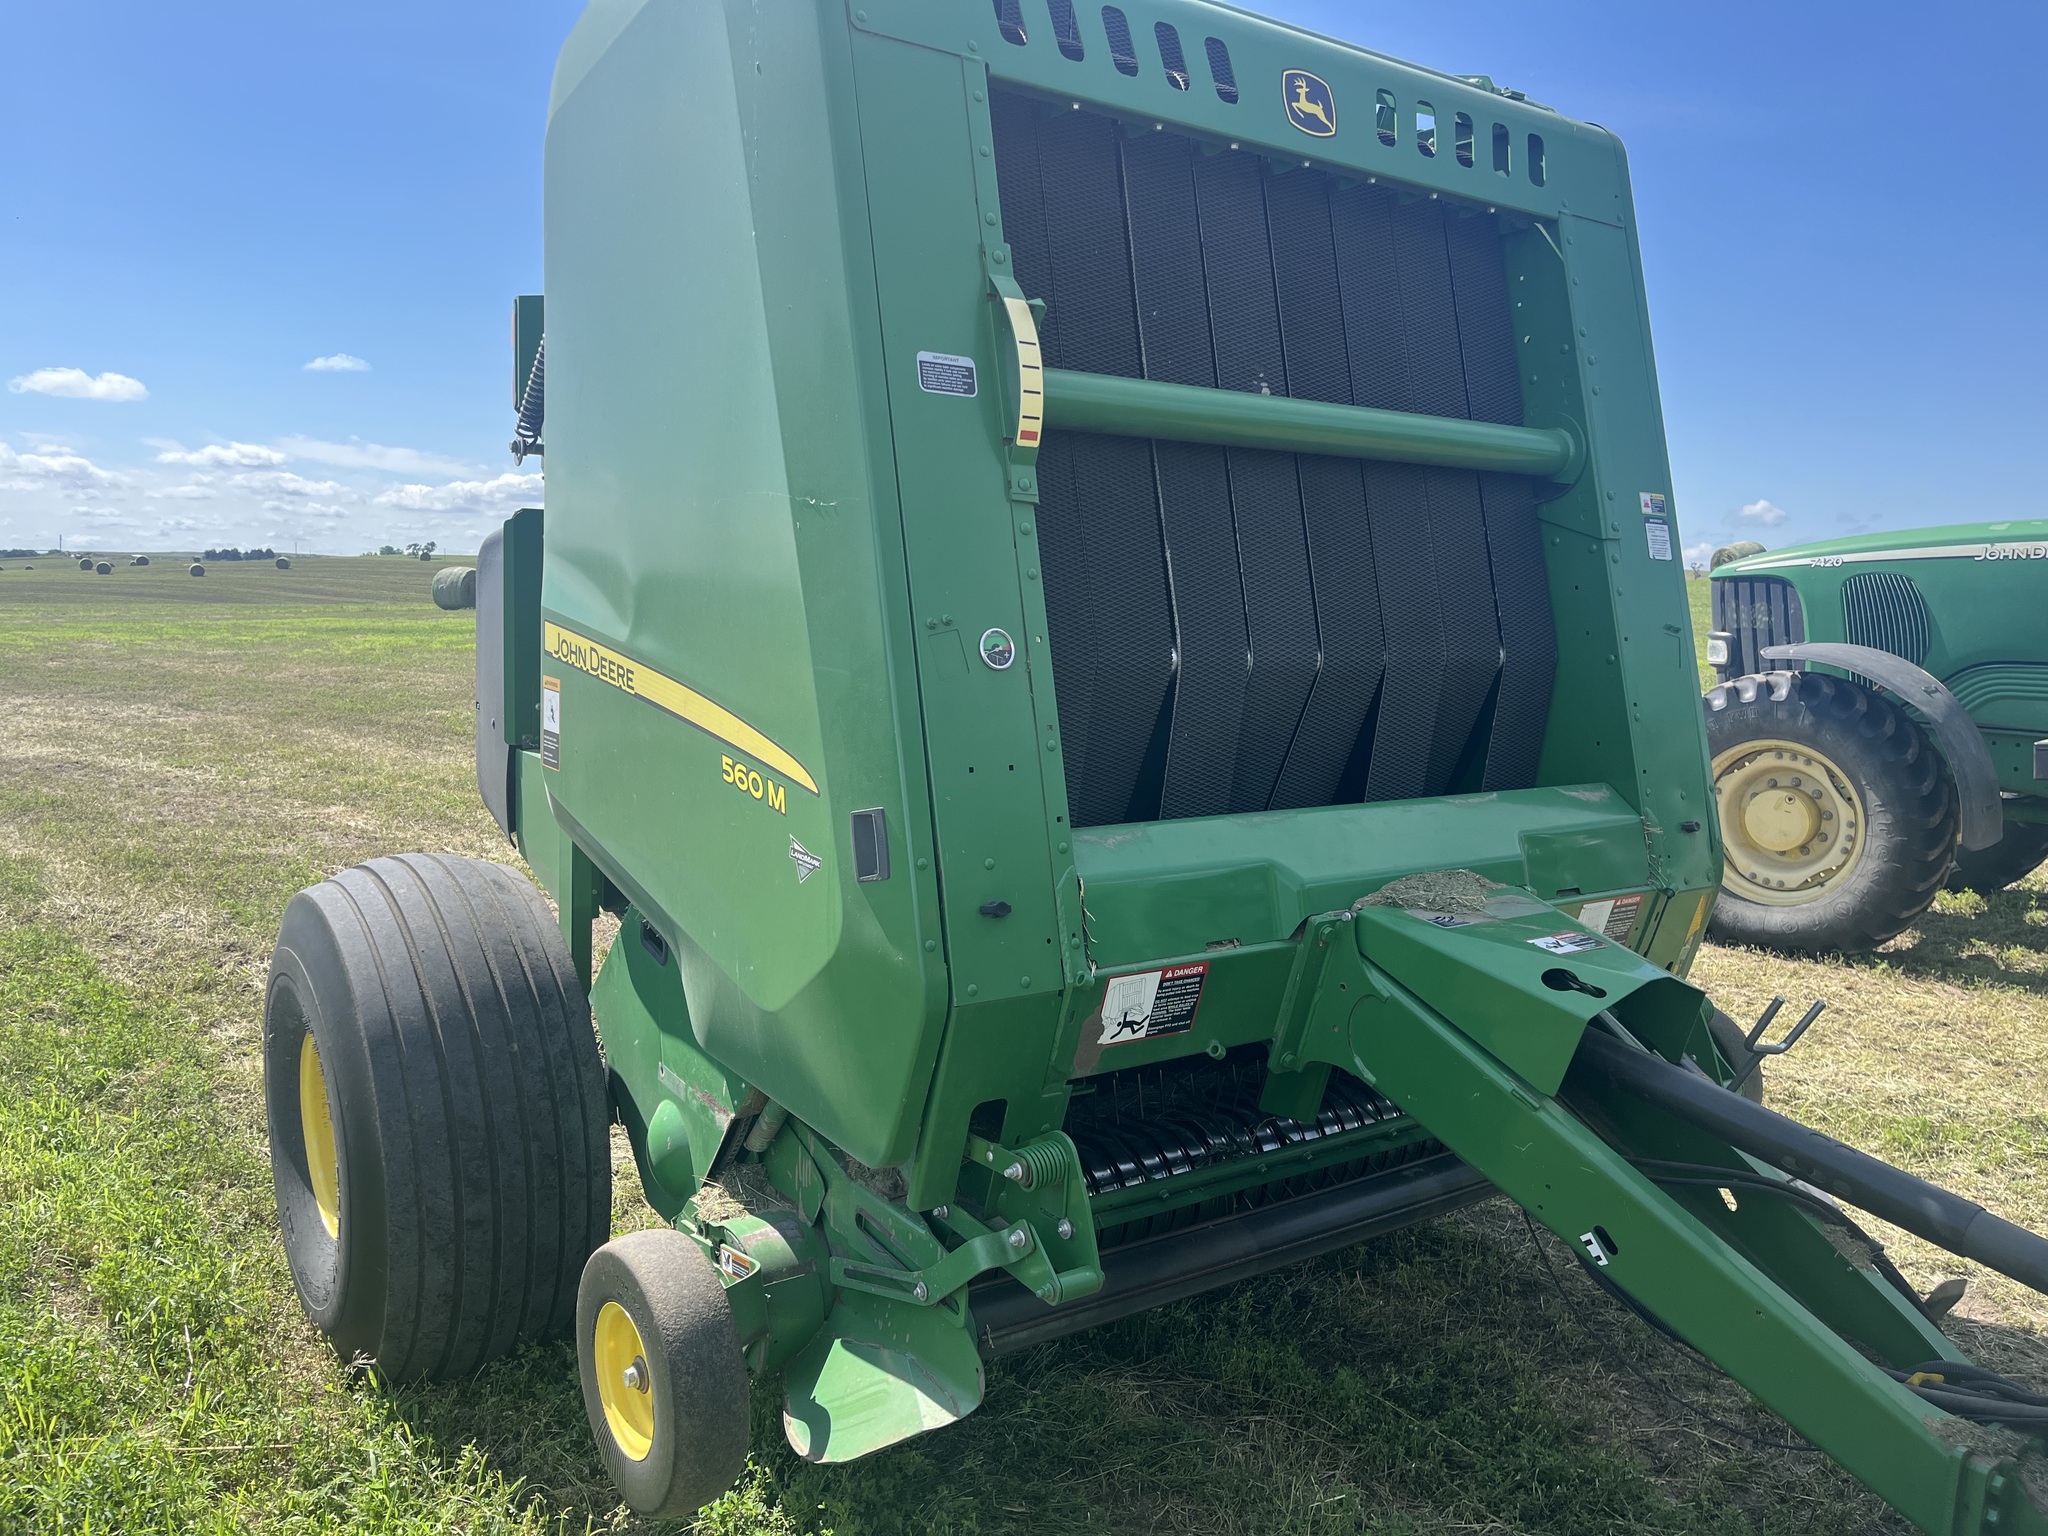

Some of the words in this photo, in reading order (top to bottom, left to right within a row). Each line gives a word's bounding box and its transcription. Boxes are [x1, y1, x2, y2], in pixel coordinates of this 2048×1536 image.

[1974, 547, 2029, 561] JOHN
[1810, 557, 1844, 567] 7420
[553, 632, 587, 671] JOHN
[589, 646, 636, 693] DEERE
[721, 753, 764, 800] 560
[767, 778, 787, 816] M
[1174, 966, 1203, 977] DANGER
